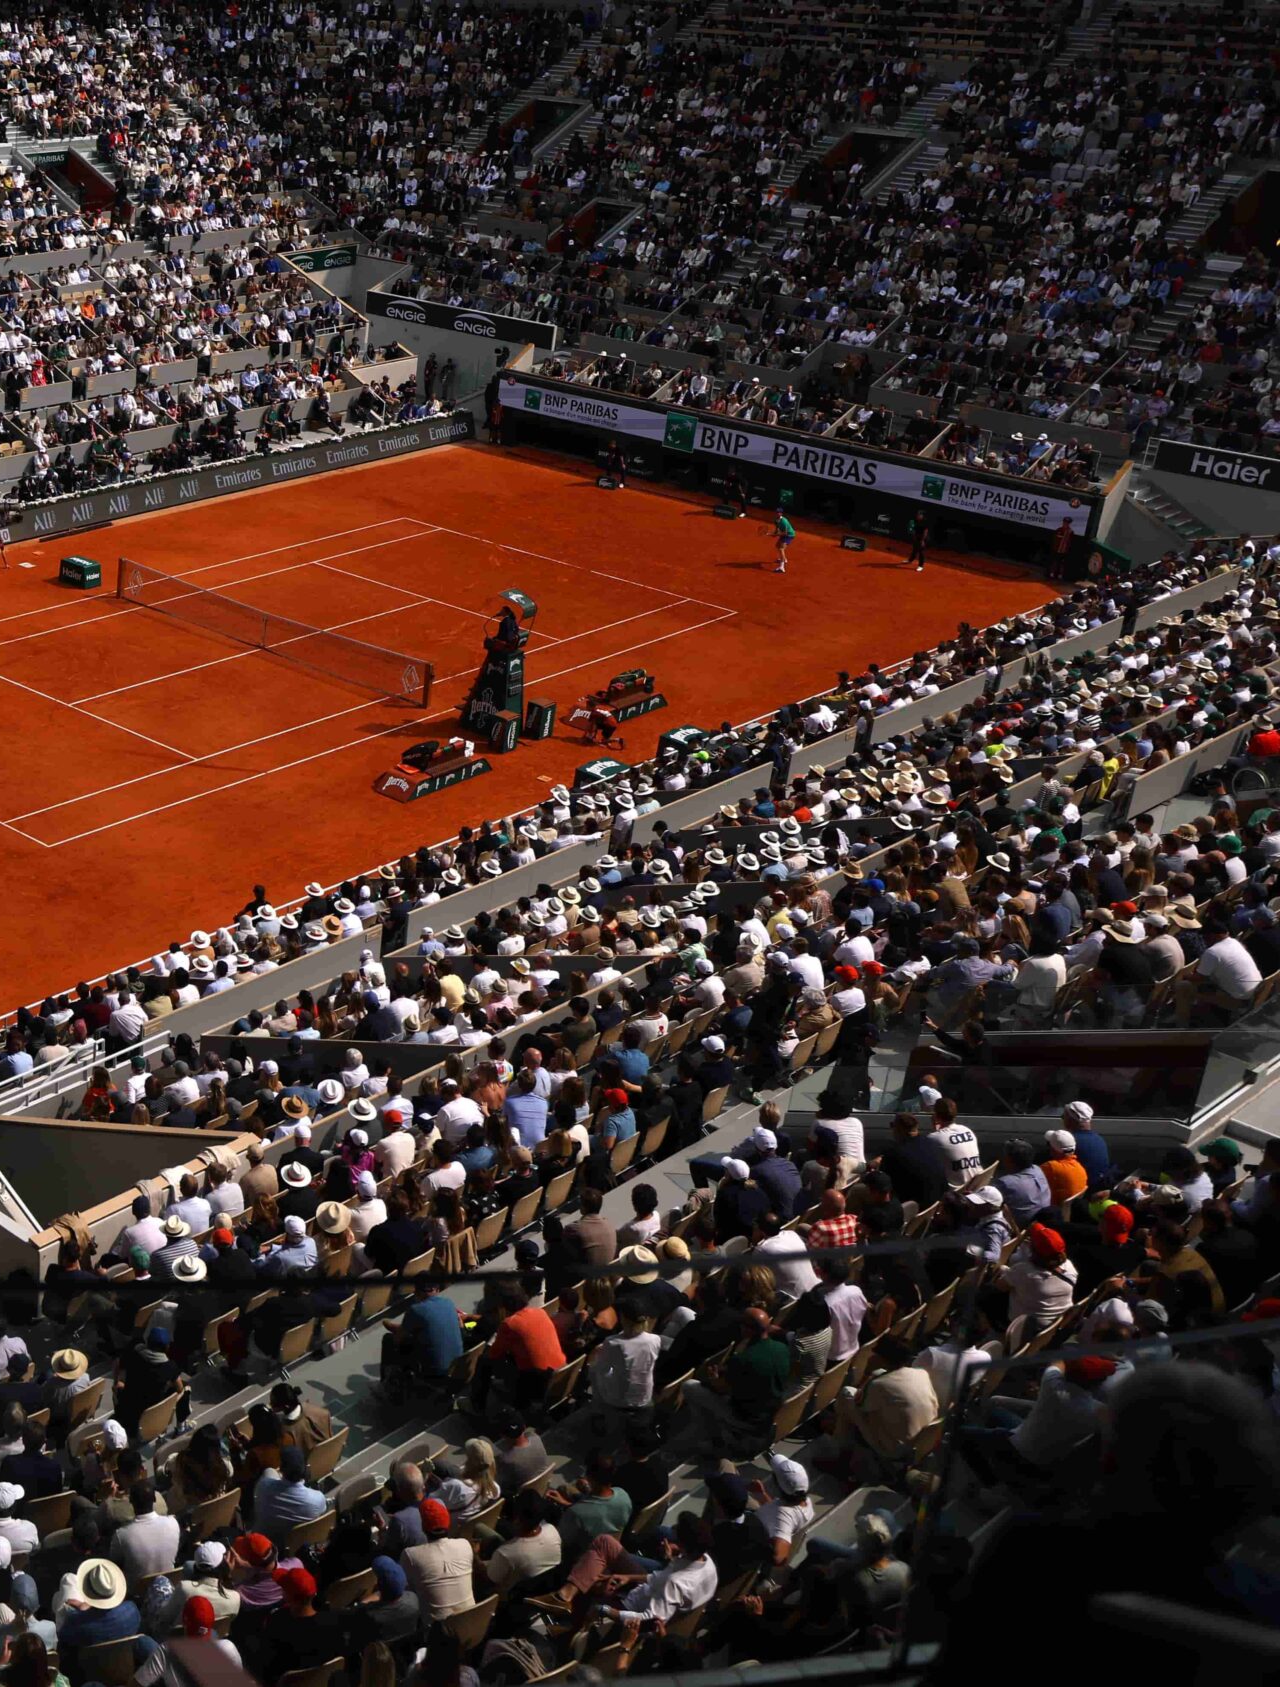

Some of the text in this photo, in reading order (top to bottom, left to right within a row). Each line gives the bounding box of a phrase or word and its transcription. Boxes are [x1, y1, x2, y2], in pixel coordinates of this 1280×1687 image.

[544, 394, 619, 420] BNP PARIBAS
[215, 468, 261, 489] Emirates
[272, 455, 317, 476] Emirates
[326, 443, 369, 464] Emirates
[378, 431, 420, 453] Emirates
[429, 421, 468, 442] Emirates
[700, 427, 878, 486] BNP PARIBAS
[1190, 452, 1271, 485] Haier
[949, 482, 1050, 516] BNP PARIBAS
[62, 566, 82, 580] Haier
[950, 1132, 974, 1145] COLE
